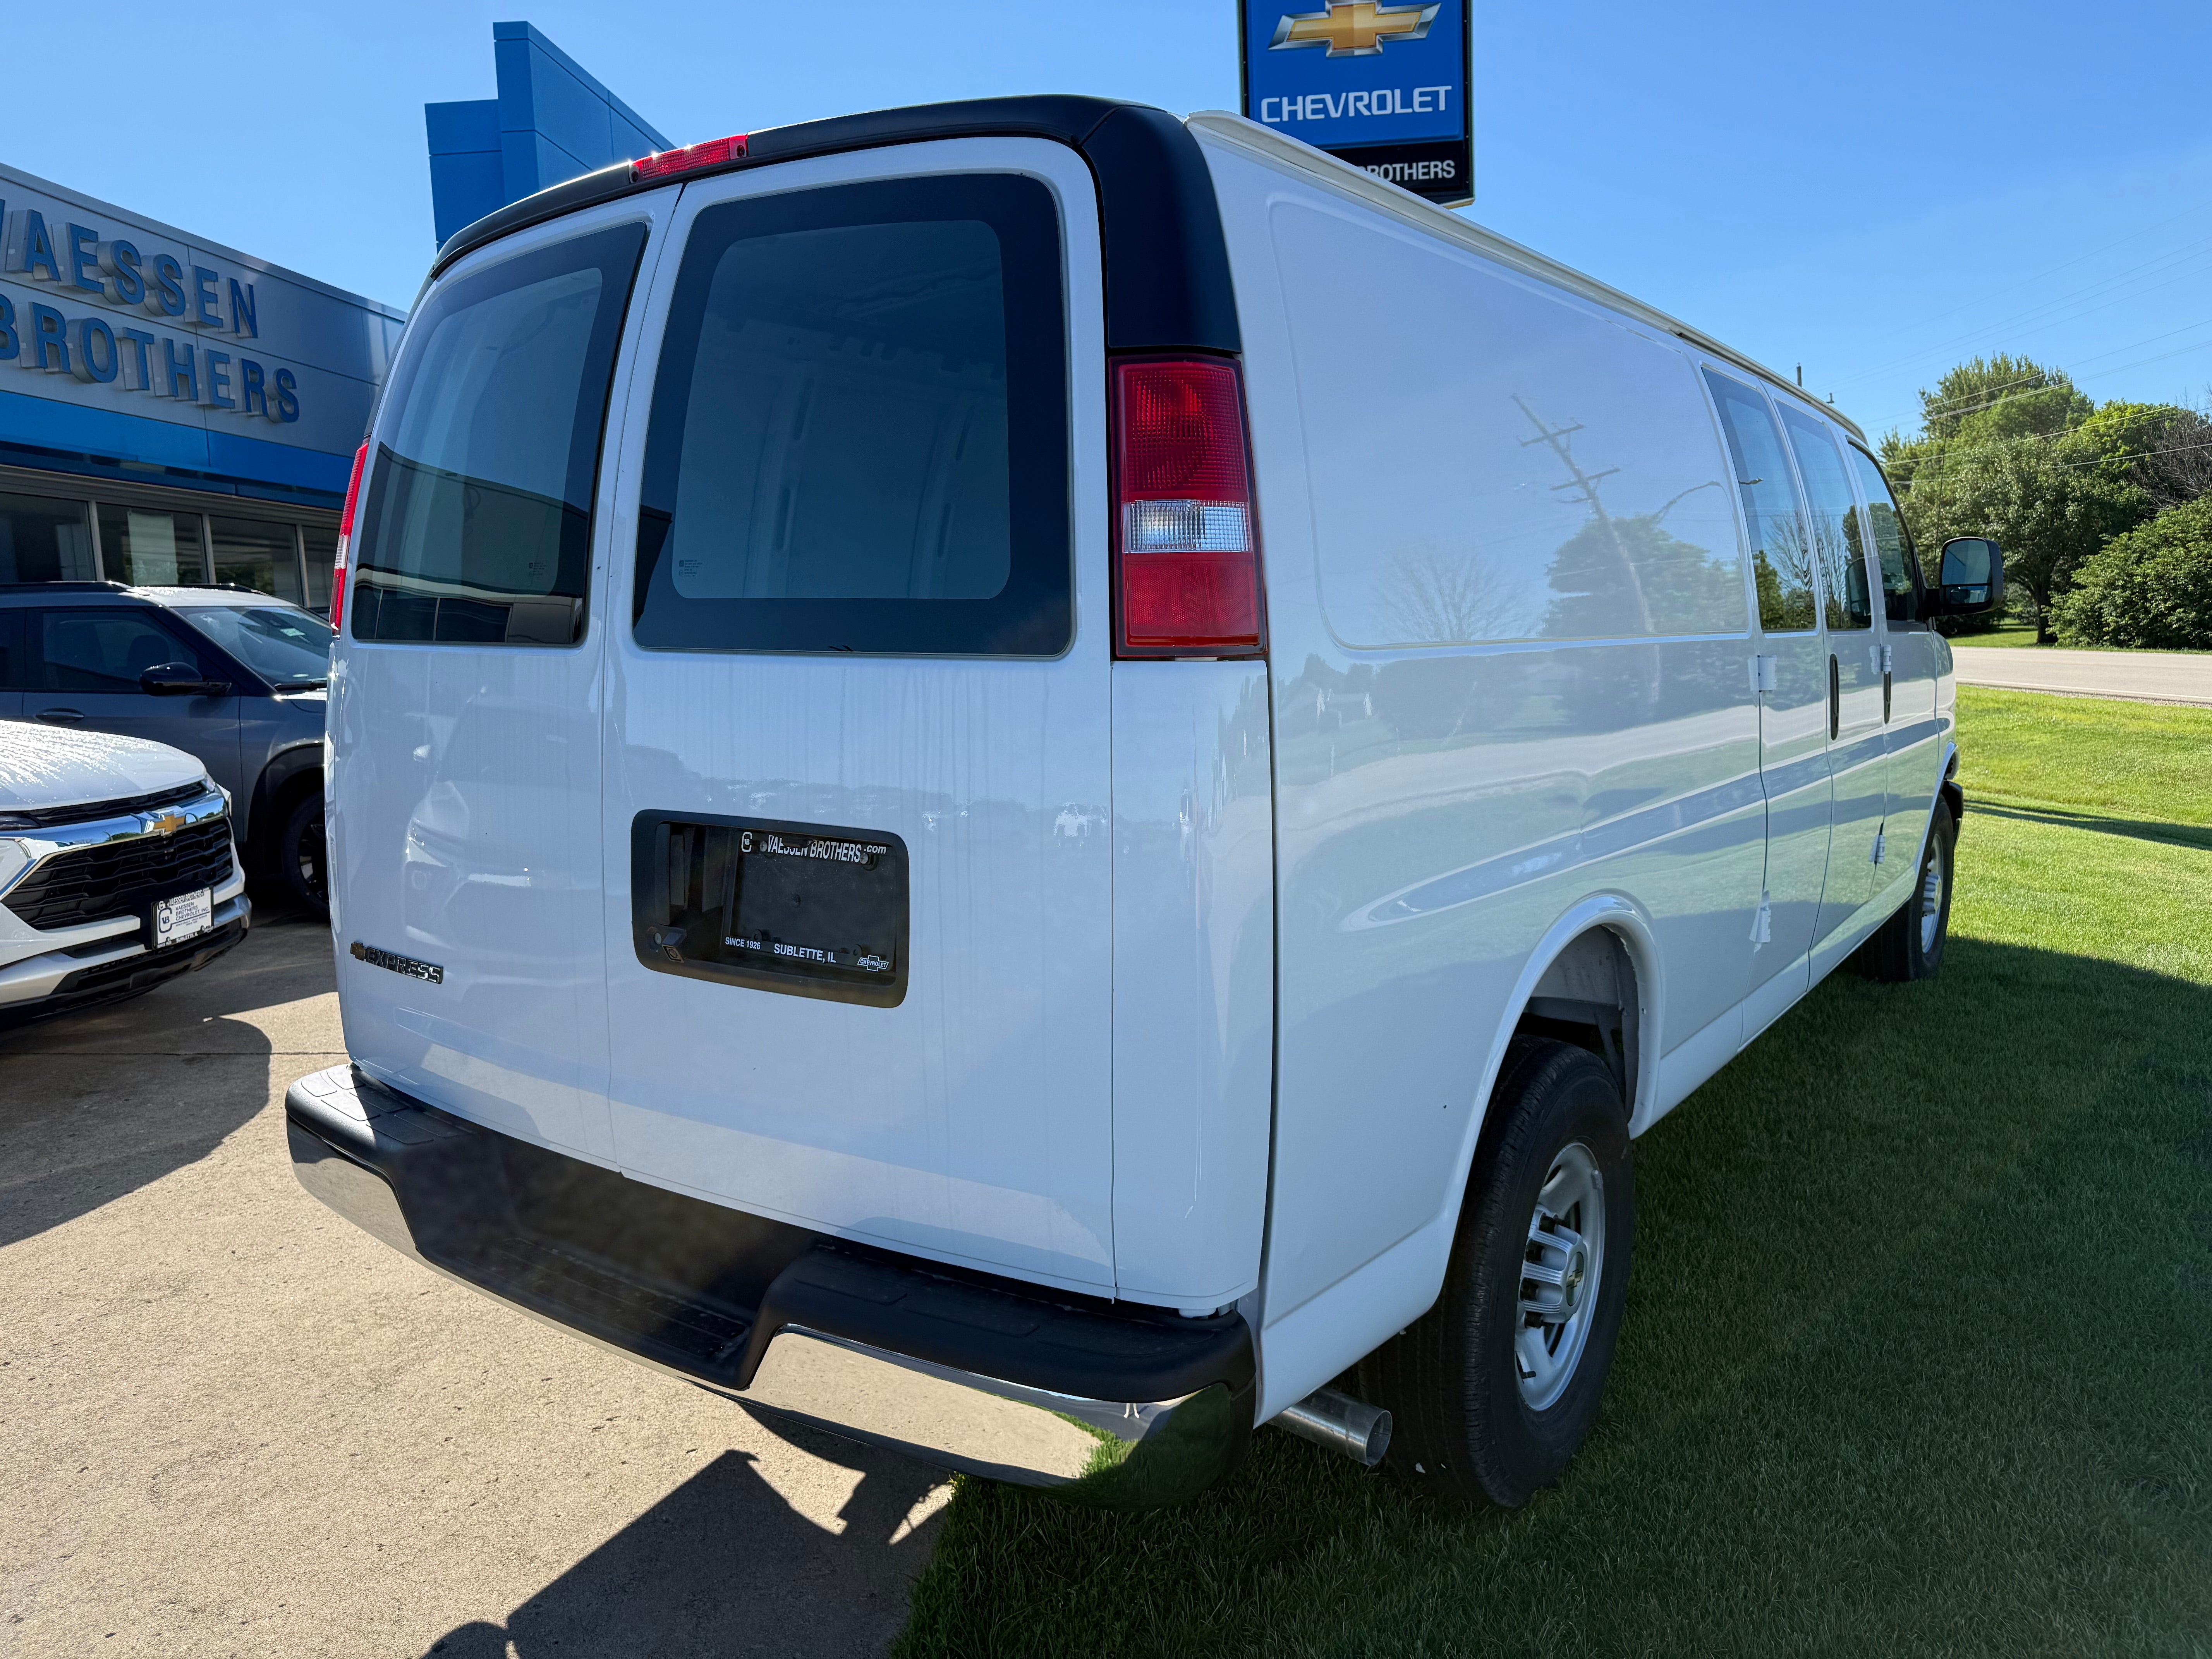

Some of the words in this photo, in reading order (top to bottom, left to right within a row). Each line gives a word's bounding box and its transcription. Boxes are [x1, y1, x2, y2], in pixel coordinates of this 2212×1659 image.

[1261, 86, 1452, 123] CHEVROLET
[1358, 160, 1455, 182] ROTHERS
[0, 198, 258, 338] AESSEN
[810, 840, 862, 863] BROTHERS
[864, 845, 887, 854] .com
[175, 902, 194, 911] VAESSEN
[725, 937, 745, 947] SINCE
[747, 940, 761, 950] 1926
[774, 943, 825, 963] SUBLETTE,
[828, 951, 836, 963] IL
[368, 948, 441, 983] EXPRESS
[860, 959, 886, 967] CHEVROLET
